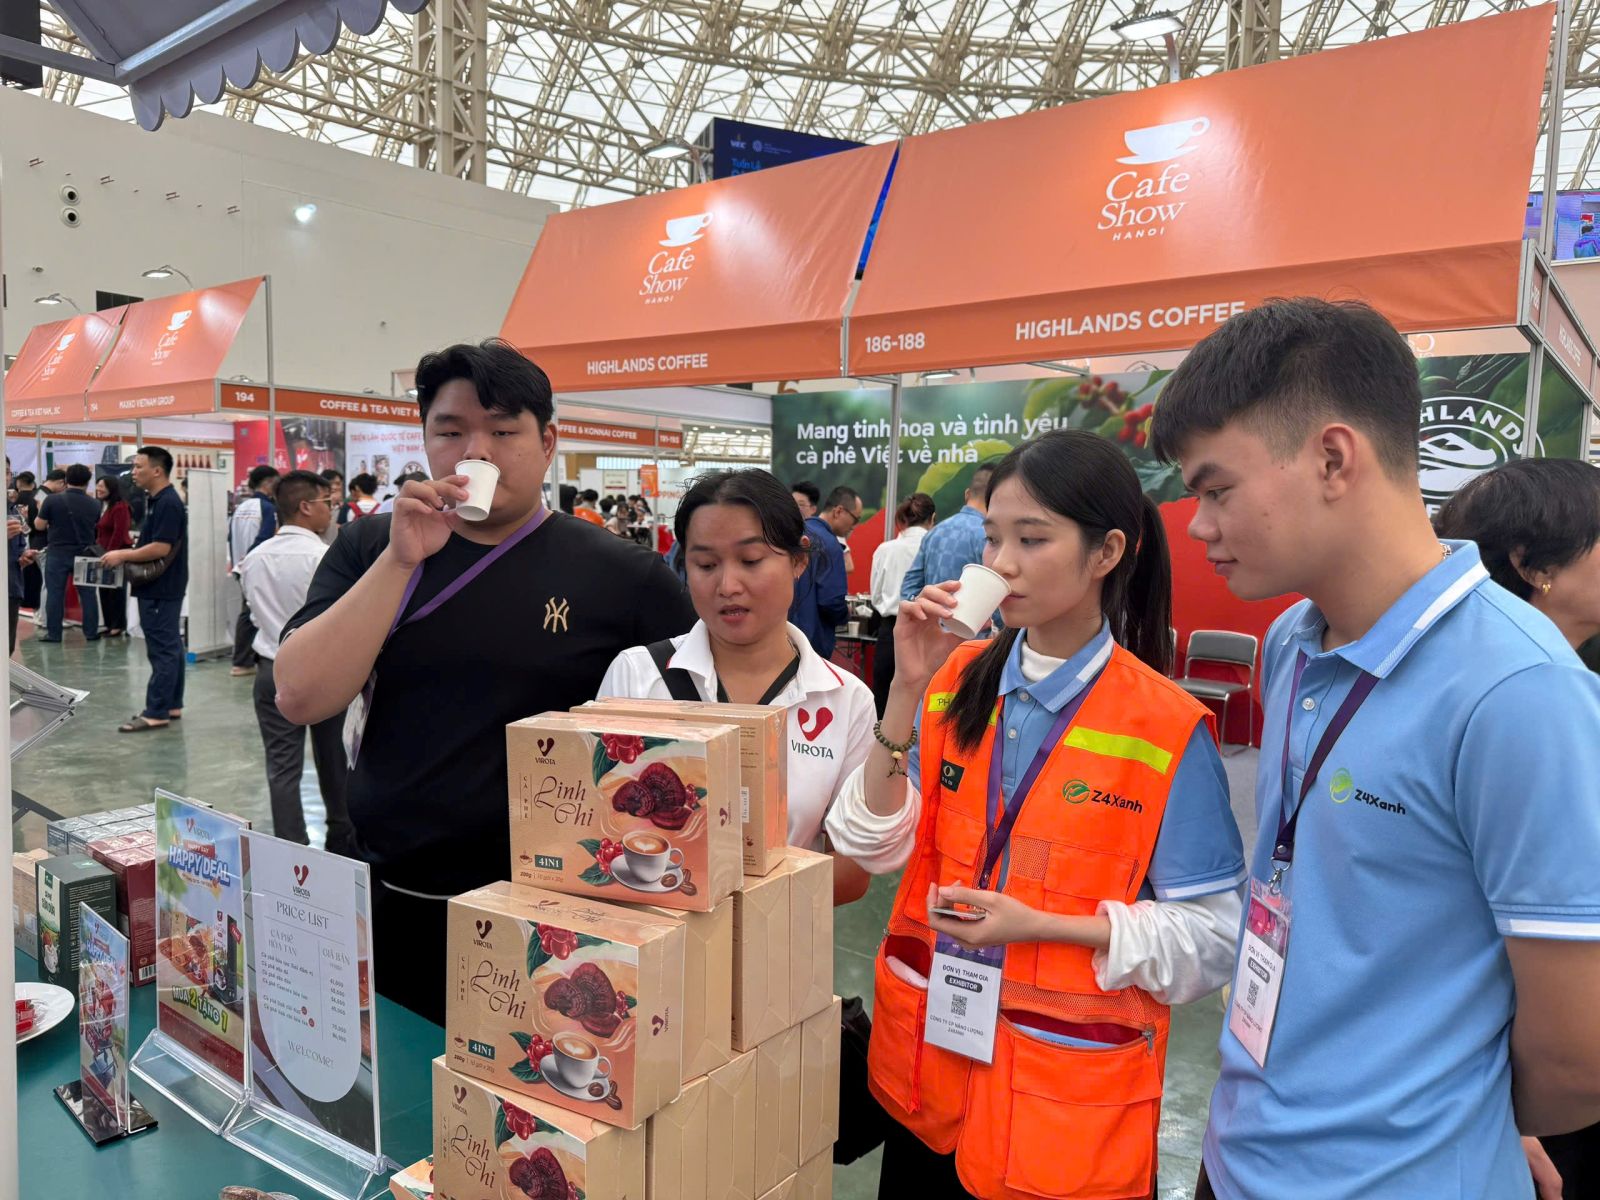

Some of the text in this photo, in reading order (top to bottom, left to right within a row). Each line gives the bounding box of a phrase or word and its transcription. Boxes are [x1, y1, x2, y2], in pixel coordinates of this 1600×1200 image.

[1097, 200, 1187, 230] Show
[1112, 228, 1164, 241] HANOI
[638, 272, 689, 296] Show
[644, 296, 674, 304] HANOI
[1015, 300, 1246, 341] HIGHLANDS COFFEE
[865, 332, 926, 353] 186-188
[587, 353, 708, 376] HIGHLANDS COFFEE
[235, 391, 255, 402] 194
[319, 399, 359, 412] COFFEE
[361, 404, 368, 412] &
[370, 404, 388, 414] TEA
[391, 406, 411, 416] VIET
[578, 426, 584, 434] &
[612, 430, 637, 440] COFFEE
[796, 411, 1068, 445] Mang tinh hoa và tình yêu
[1420, 405, 1526, 455] HLAND
[796, 442, 818, 464] cà
[822, 446, 856, 469] phê
[908, 438, 933, 464] về
[937, 440, 978, 464] nhà
[535, 757, 556, 766] VIROTA
[791, 739, 834, 760] VIROTA
[534, 776, 586, 808] Linh
[1091, 790, 1144, 814] Z4Xanh
[1354, 788, 1406, 815] Z4Xanh
[554, 803, 594, 826] Chi
[168, 845, 201, 873] HAPPY
[202, 857, 230, 886] DEAL
[276, 901, 329, 929] PRICE LIST
[473, 939, 492, 950] VIROTA
[470, 960, 520, 993] Linh
[949, 978, 978, 991] EXHIBITOR
[962, 970, 978, 979] THAM
[979, 974, 989, 982] GIA
[172, 985, 189, 1003] MUA
[189, 988, 197, 1010] 2
[221, 1010, 228, 1033] 1
[489, 990, 526, 1020] Chi
[472, 1043, 492, 1057] 4IN1
[450, 1124, 490, 1160] Linh
[465, 1156, 496, 1188] Chi
